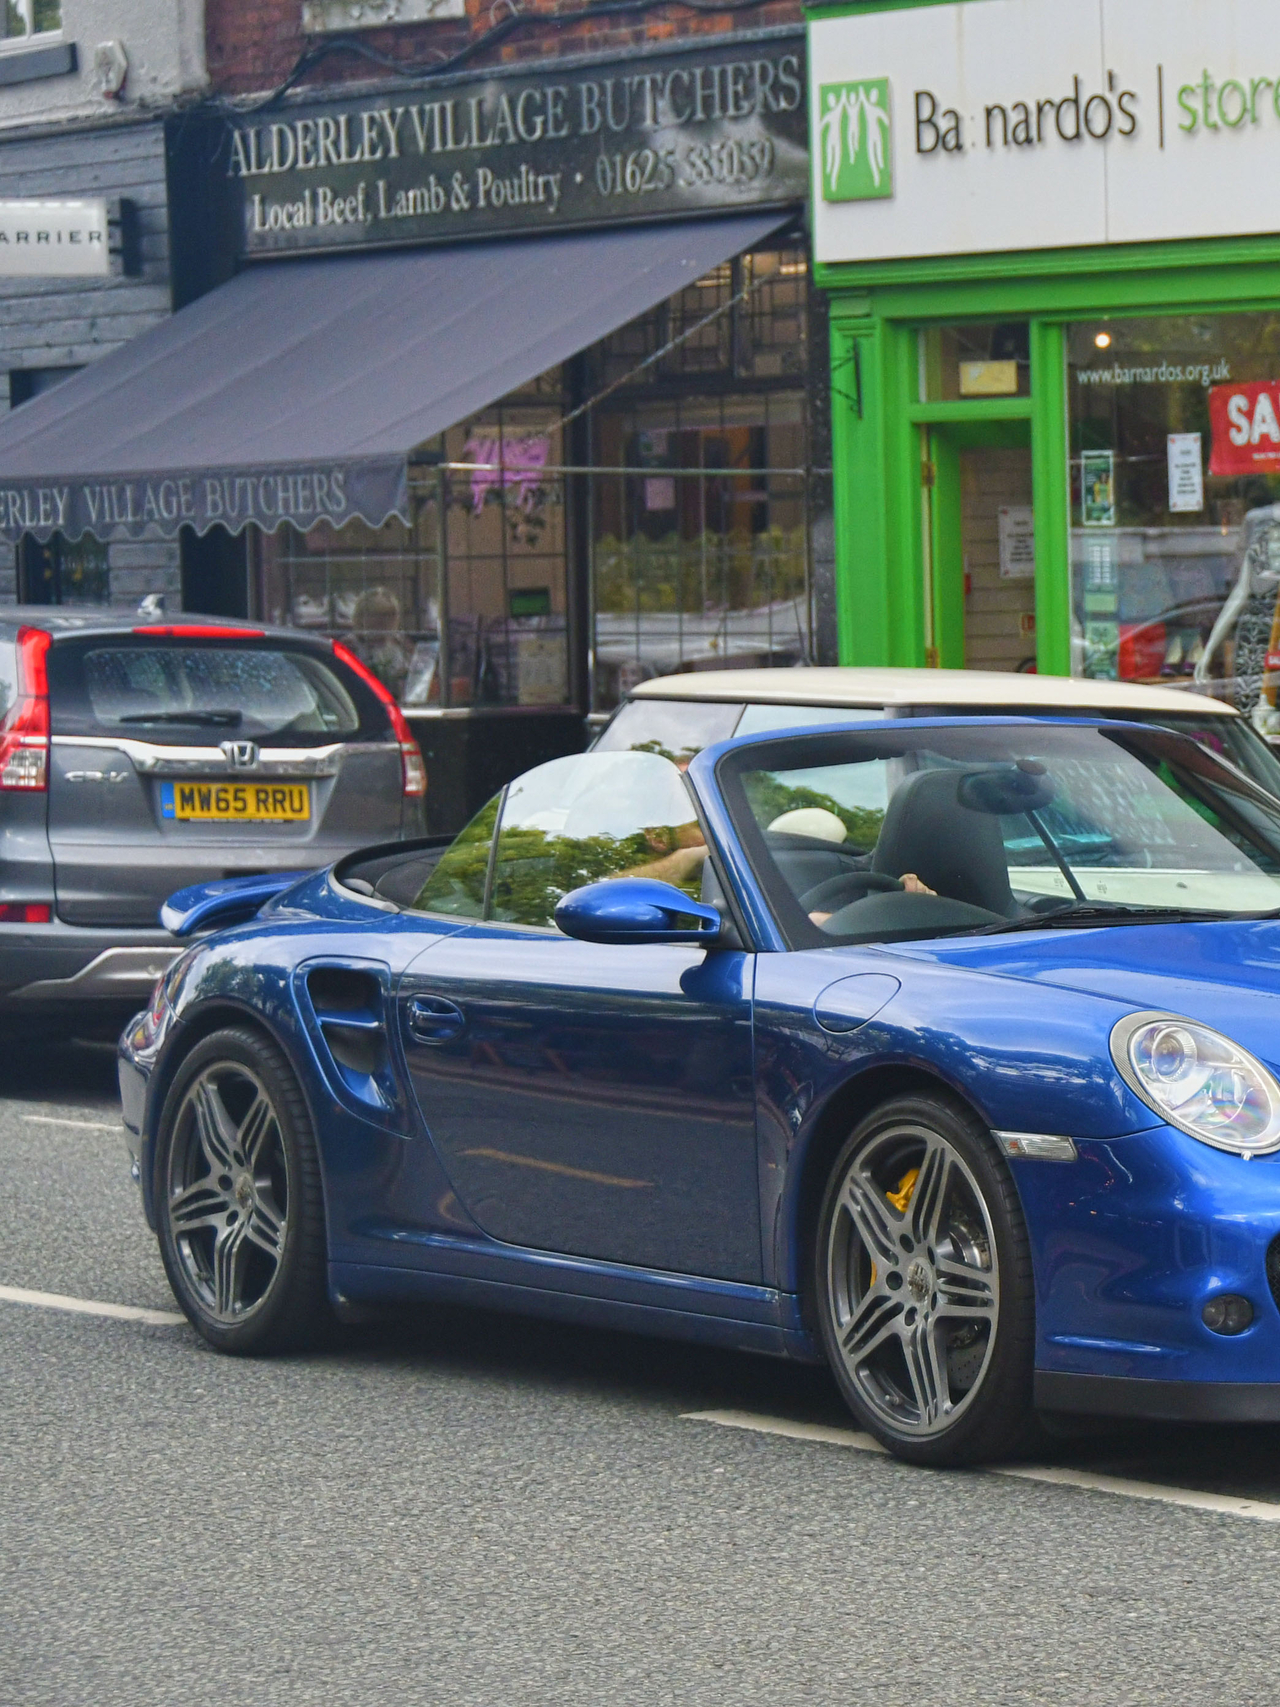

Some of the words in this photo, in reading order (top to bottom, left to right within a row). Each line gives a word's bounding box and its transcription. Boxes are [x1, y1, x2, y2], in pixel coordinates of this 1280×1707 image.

[226, 106, 405, 177] ALDERLEY
[409, 85, 569, 154] VILLAGE
[579, 55, 800, 135] BUTCHERS
[252, 188, 312, 232] Local
[316, 179, 374, 226] Beef,
[377, 173, 445, 219] Lamb
[450, 170, 470, 212] &
[477, 163, 561, 212] Poultry
[597, 149, 675, 197] 01625
[1077, 357, 1231, 387] www.barnardos.org.uk
[83, 479, 196, 524] VILLAGE
[204, 471, 347, 518] BUTCHERS
[180, 787, 247, 812] MW65
[255, 787, 304, 813] RRU
